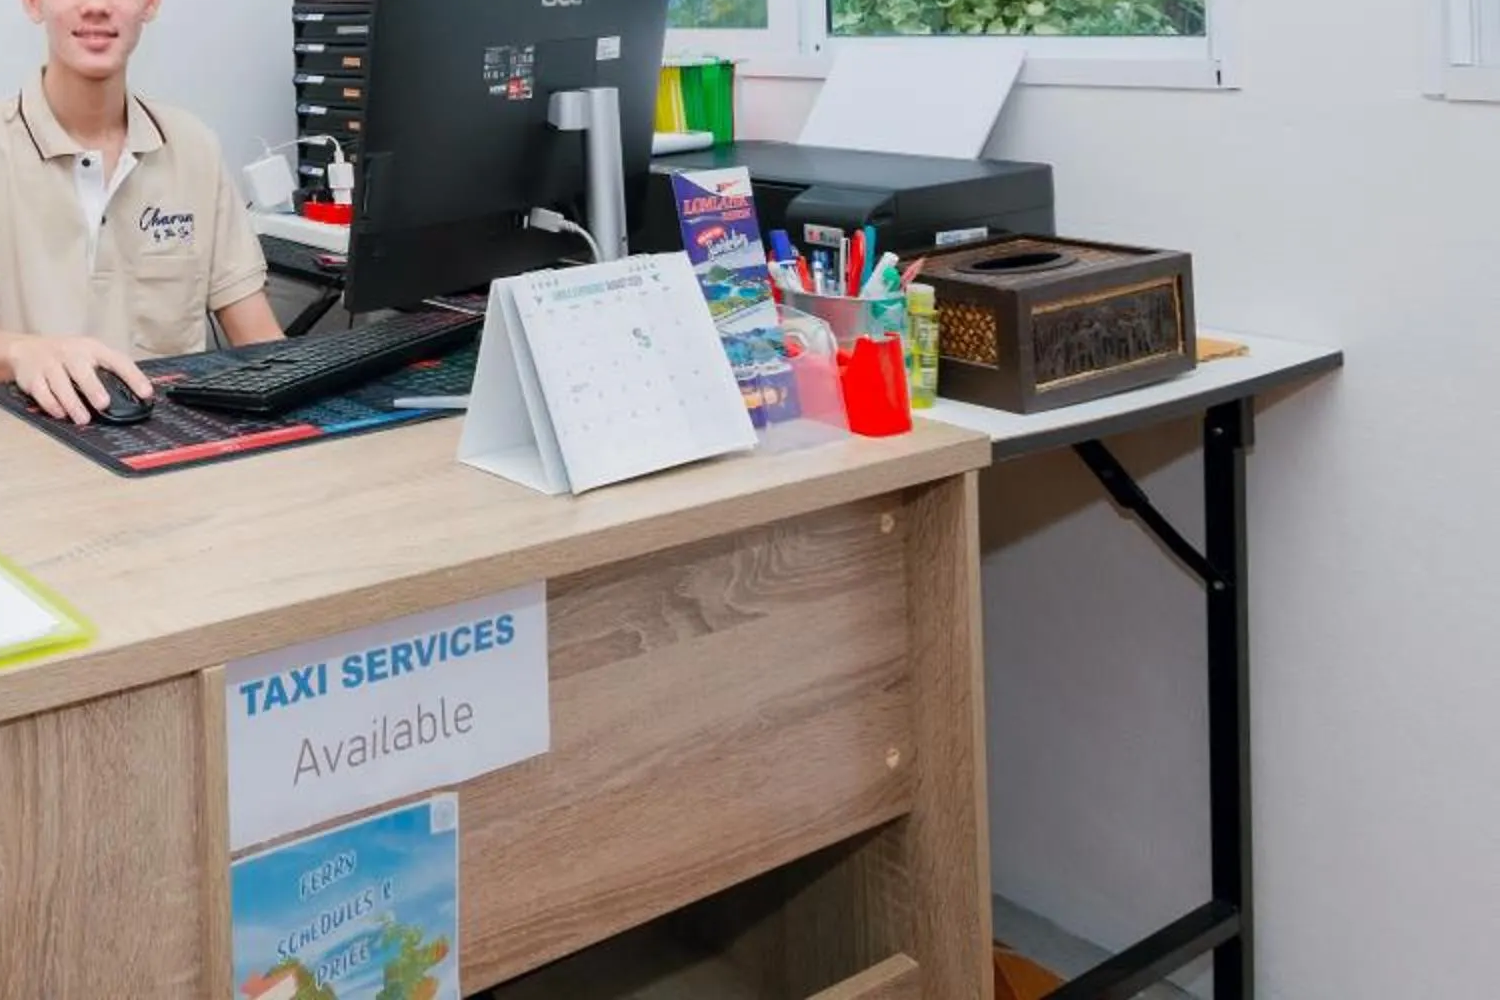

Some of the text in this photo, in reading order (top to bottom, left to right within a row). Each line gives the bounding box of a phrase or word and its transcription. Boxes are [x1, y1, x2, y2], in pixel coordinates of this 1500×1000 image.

[239, 614, 515, 717] TAXI SERVICES
[293, 696, 475, 787] Available
[300, 852, 355, 898] FERRY
[277, 888, 374, 961] SCHEDULES
